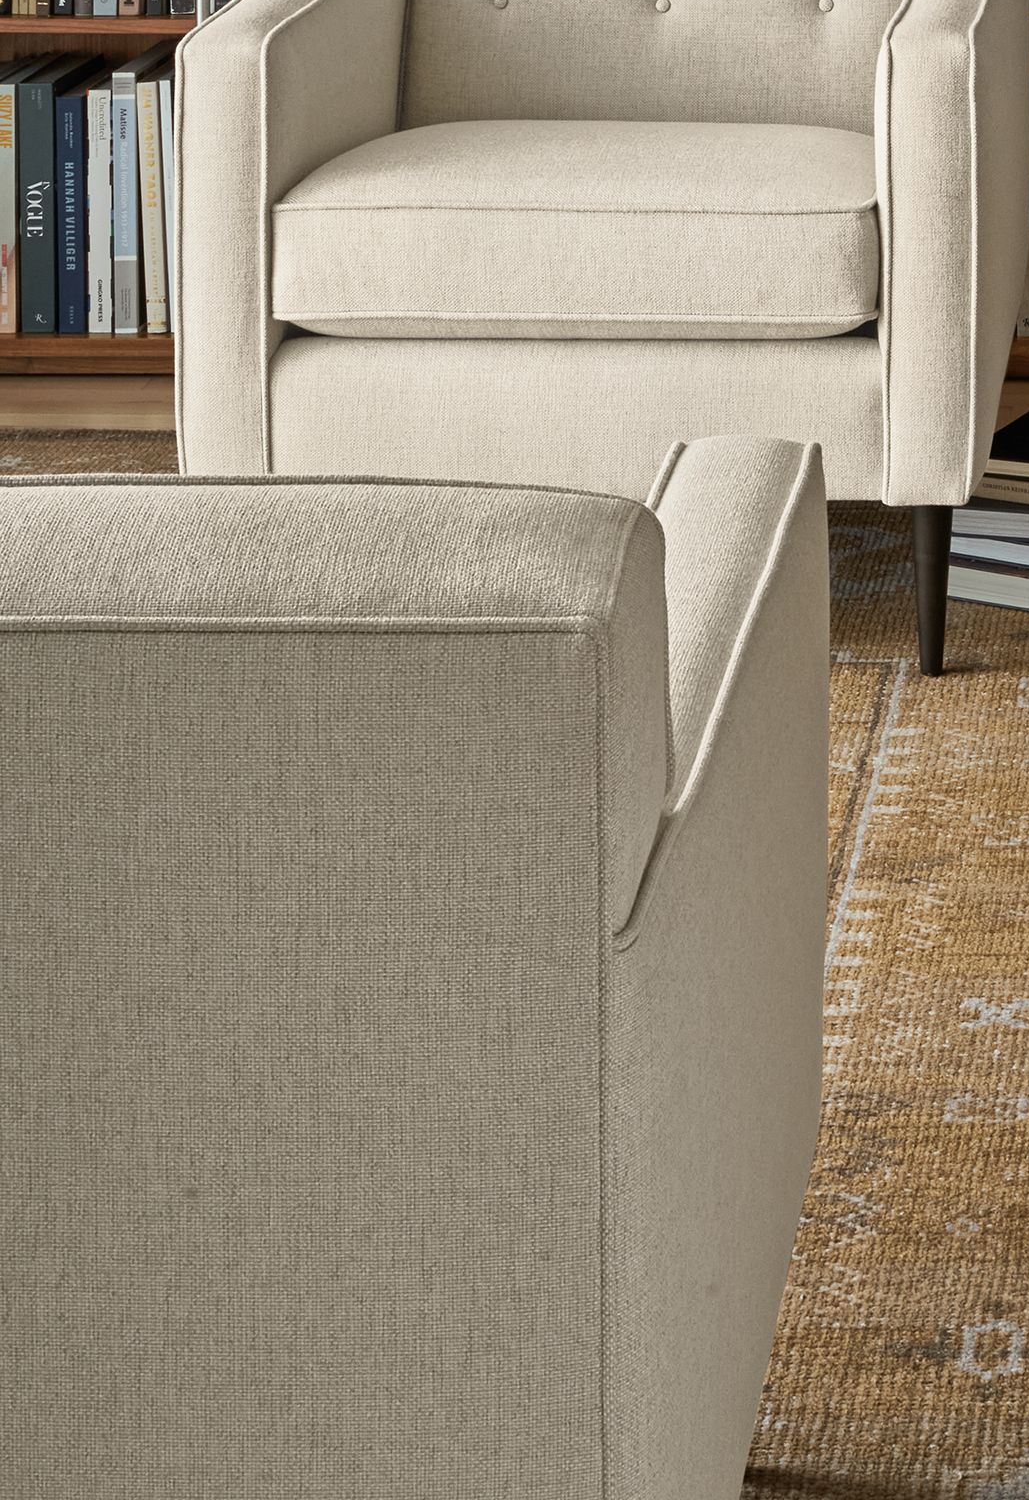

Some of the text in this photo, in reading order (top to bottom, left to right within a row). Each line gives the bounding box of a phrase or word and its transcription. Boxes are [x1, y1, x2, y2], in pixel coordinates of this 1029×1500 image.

[26, 181, 44, 237] VOGUE
[42, 181, 50, 190] IN
[65, 162, 75, 271] HANNAH VILLIGER
